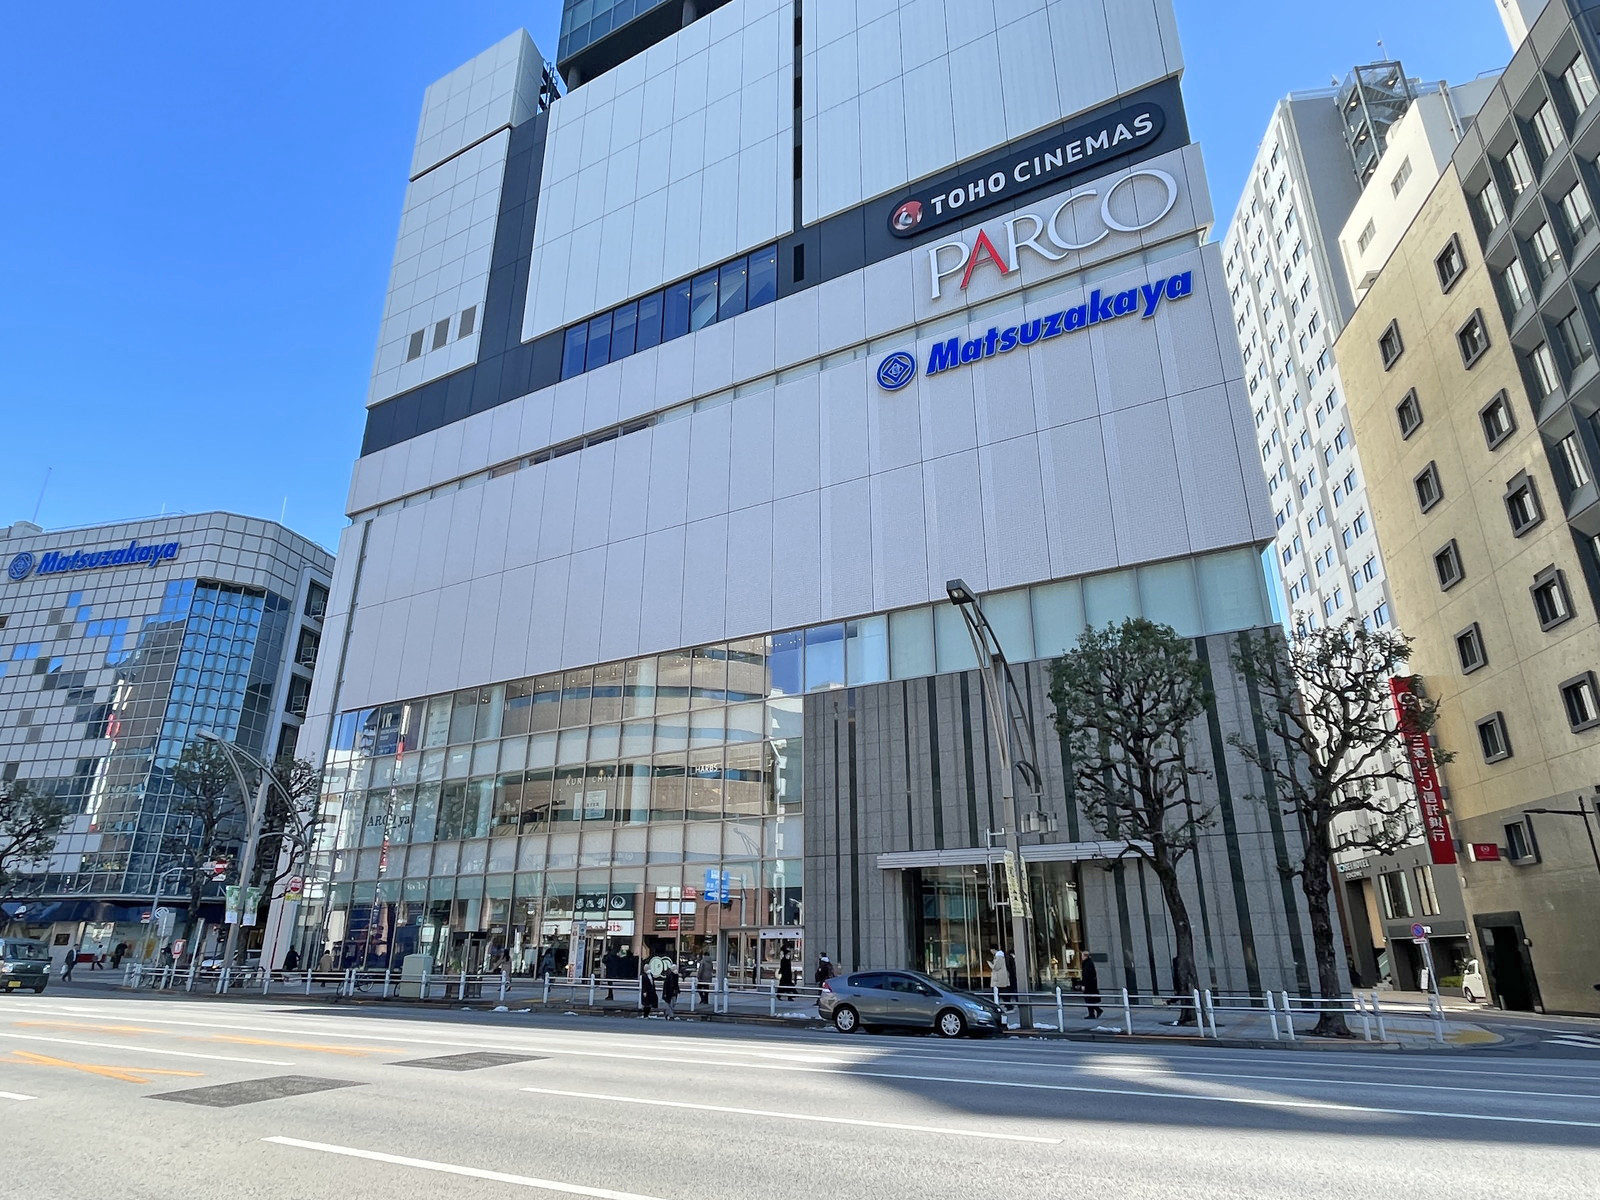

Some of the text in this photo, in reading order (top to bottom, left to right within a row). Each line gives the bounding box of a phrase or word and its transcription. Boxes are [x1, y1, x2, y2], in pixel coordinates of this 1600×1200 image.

[931, 112, 1154, 216] TOHO CINEMAS
[927, 168, 1179, 300] PARCO
[925, 270, 1193, 377] Matsuzakaya
[35, 540, 180, 576] Matsuzakaya
[565, 776, 583, 786] KUR
